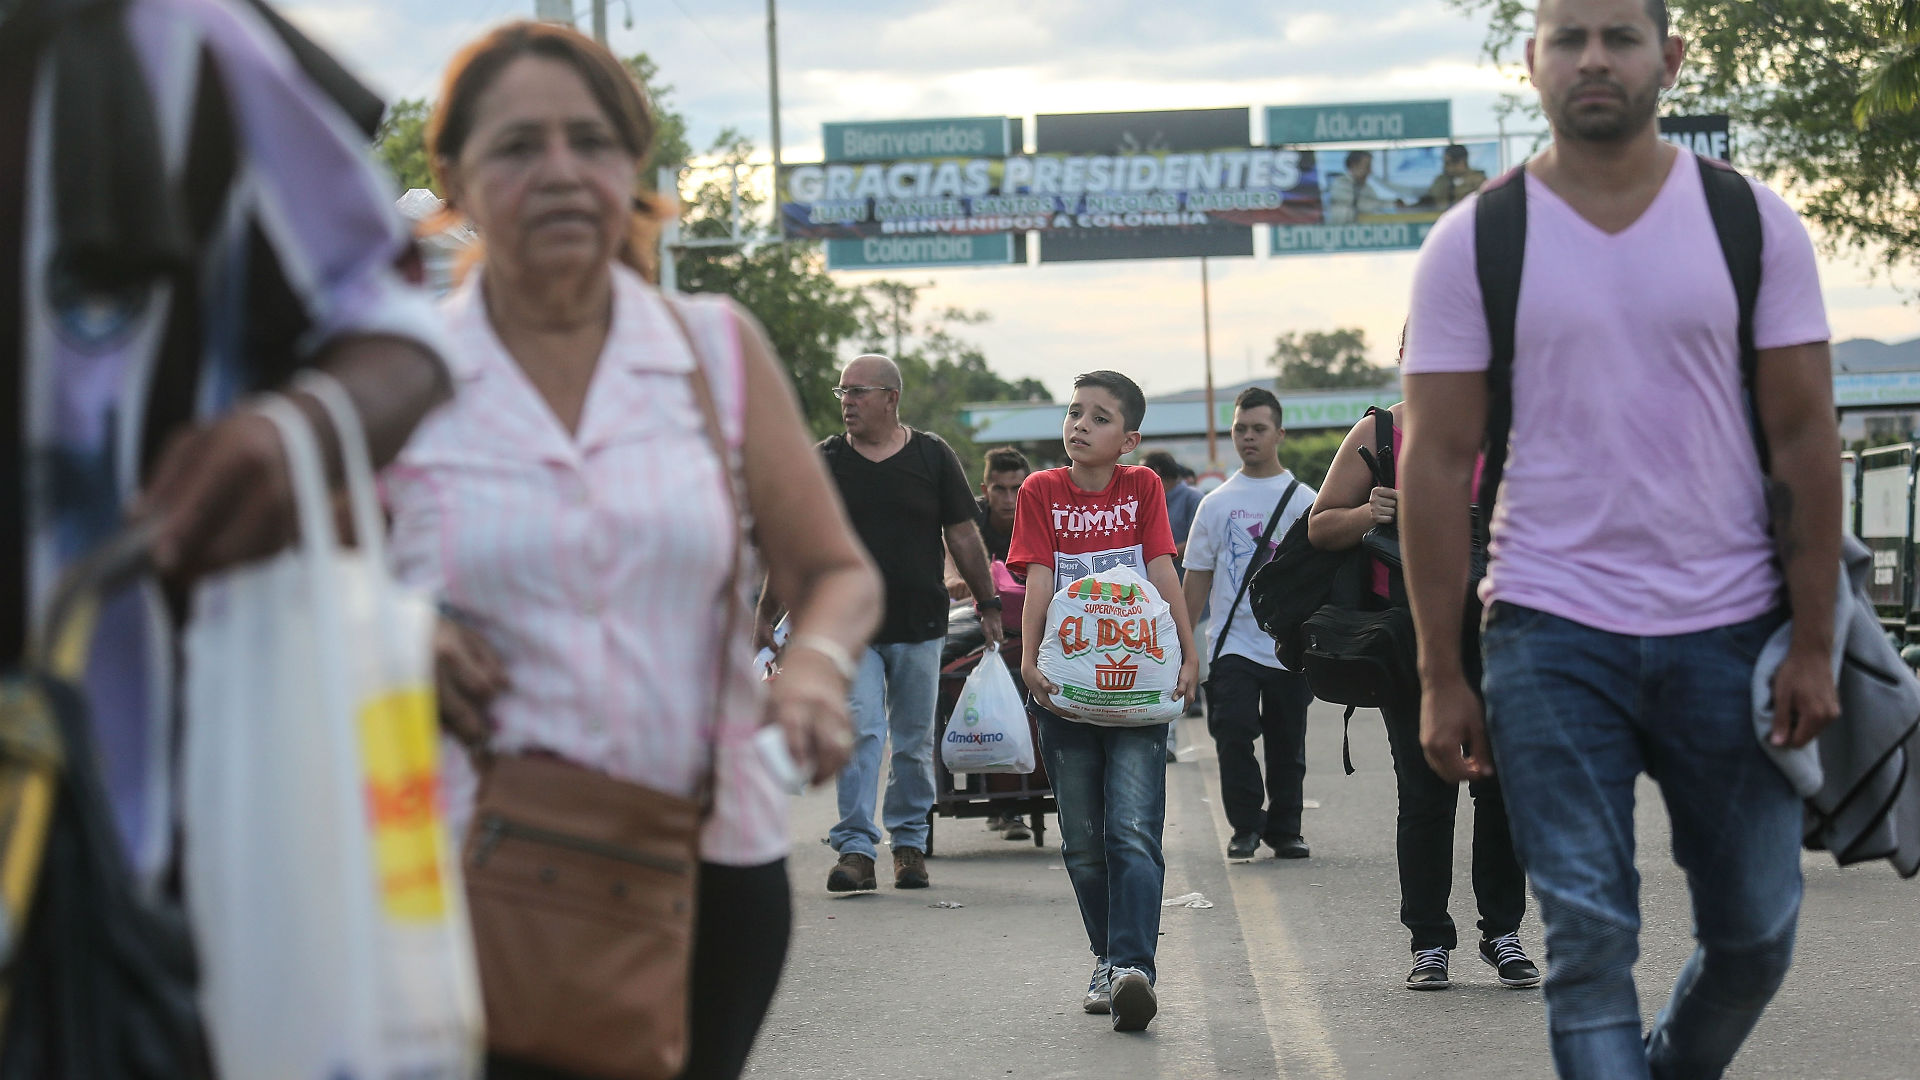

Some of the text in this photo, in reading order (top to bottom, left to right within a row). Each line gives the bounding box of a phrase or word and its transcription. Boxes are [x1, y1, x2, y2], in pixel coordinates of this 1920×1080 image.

[843, 126, 985, 156] Bienvenidos
[788, 149, 1301, 200] GRACIAS PRESIDENTES
[809, 203, 867, 223] JUAN
[874, 198, 966, 221] MANUEL
[970, 195, 1052, 217] SANTOS
[1063, 195, 1080, 213] Y
[1187, 190, 1284, 212] MADURO
[881, 216, 1049, 235] BIENVENIDOS
[1052, 213, 1073, 229] A
[1077, 212, 1209, 229] COLOMBIA
[863, 235, 973, 263] Colombia
[1052, 501, 1139, 532] TOMMY
[1084, 603, 1143, 617] SUPERMERCADO
[1058, 616, 1164, 660] EL IDEAL
